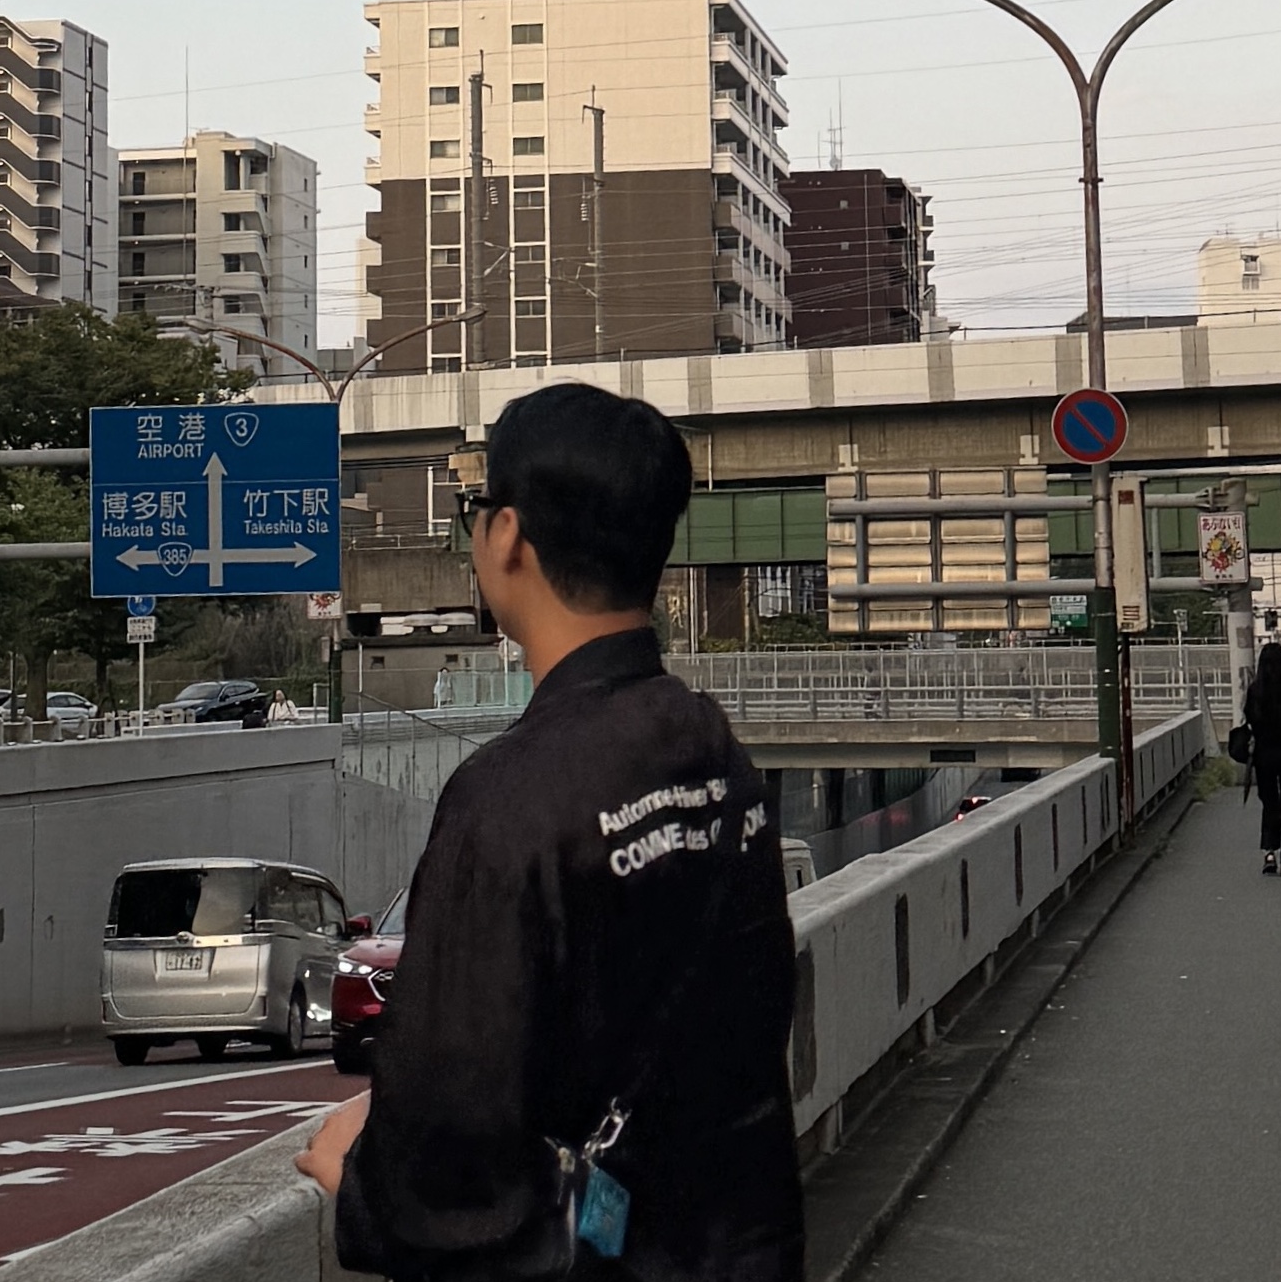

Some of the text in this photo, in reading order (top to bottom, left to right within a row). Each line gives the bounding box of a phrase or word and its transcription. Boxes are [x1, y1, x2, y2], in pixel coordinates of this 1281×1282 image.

[136, 412, 206, 443] 空港
[234, 418, 248, 438] 3
[137, 442, 205, 459] AIRPORT
[101, 490, 187, 521] 博多駅
[243, 487, 331, 518] 竹下駅
[102, 522, 154, 537] Hakata
[244, 518, 302, 535] Takeshita
[162, 548, 188, 566] 385
